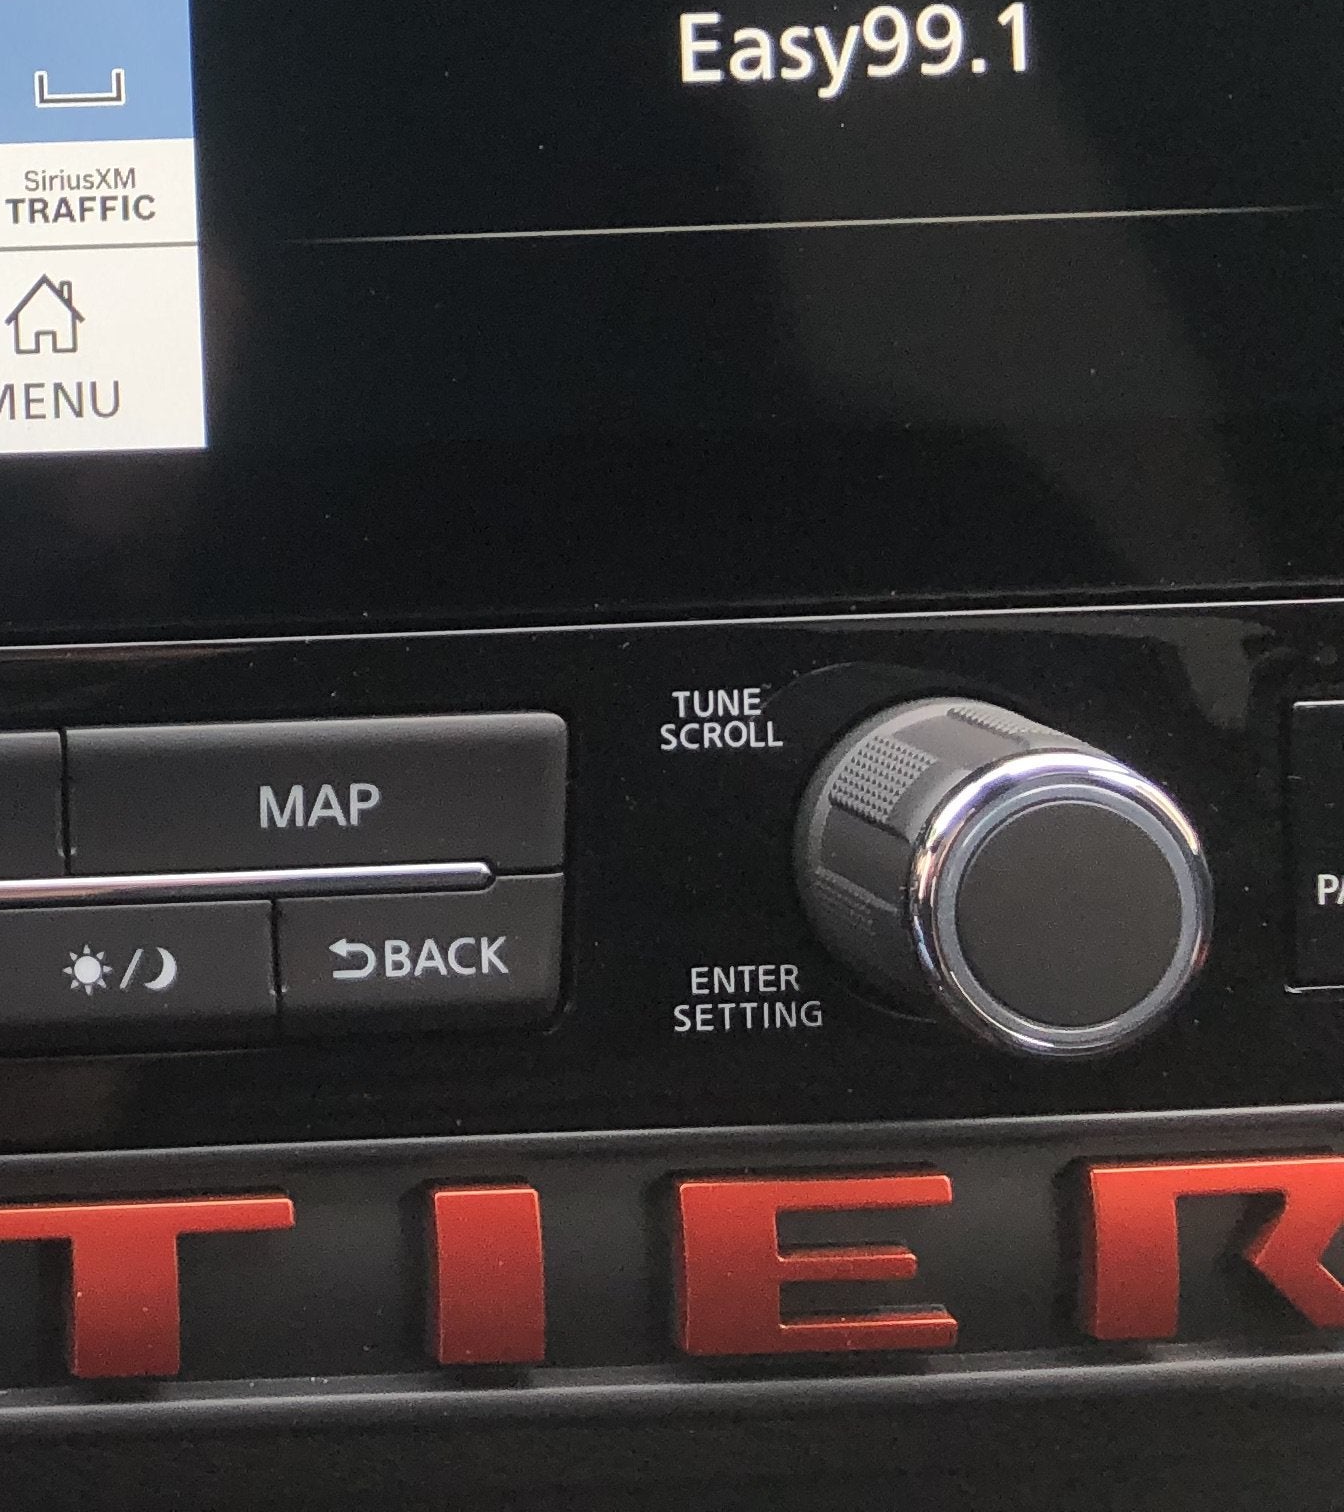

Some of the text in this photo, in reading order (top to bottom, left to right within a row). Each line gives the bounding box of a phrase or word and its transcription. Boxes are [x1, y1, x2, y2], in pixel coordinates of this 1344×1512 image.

[679, 0, 1030, 100] Easy99.1
[23, 167, 137, 193] SiriusXM
[5, 194, 157, 225] TRAFFIC
[671, 687, 763, 719] TUNE
[659, 720, 784, 751] SCROLL
[259, 782, 382, 829] MAP
[383, 936, 510, 979] BACK
[689, 963, 801, 995] ENTER
[672, 1000, 824, 1033] SETTING
